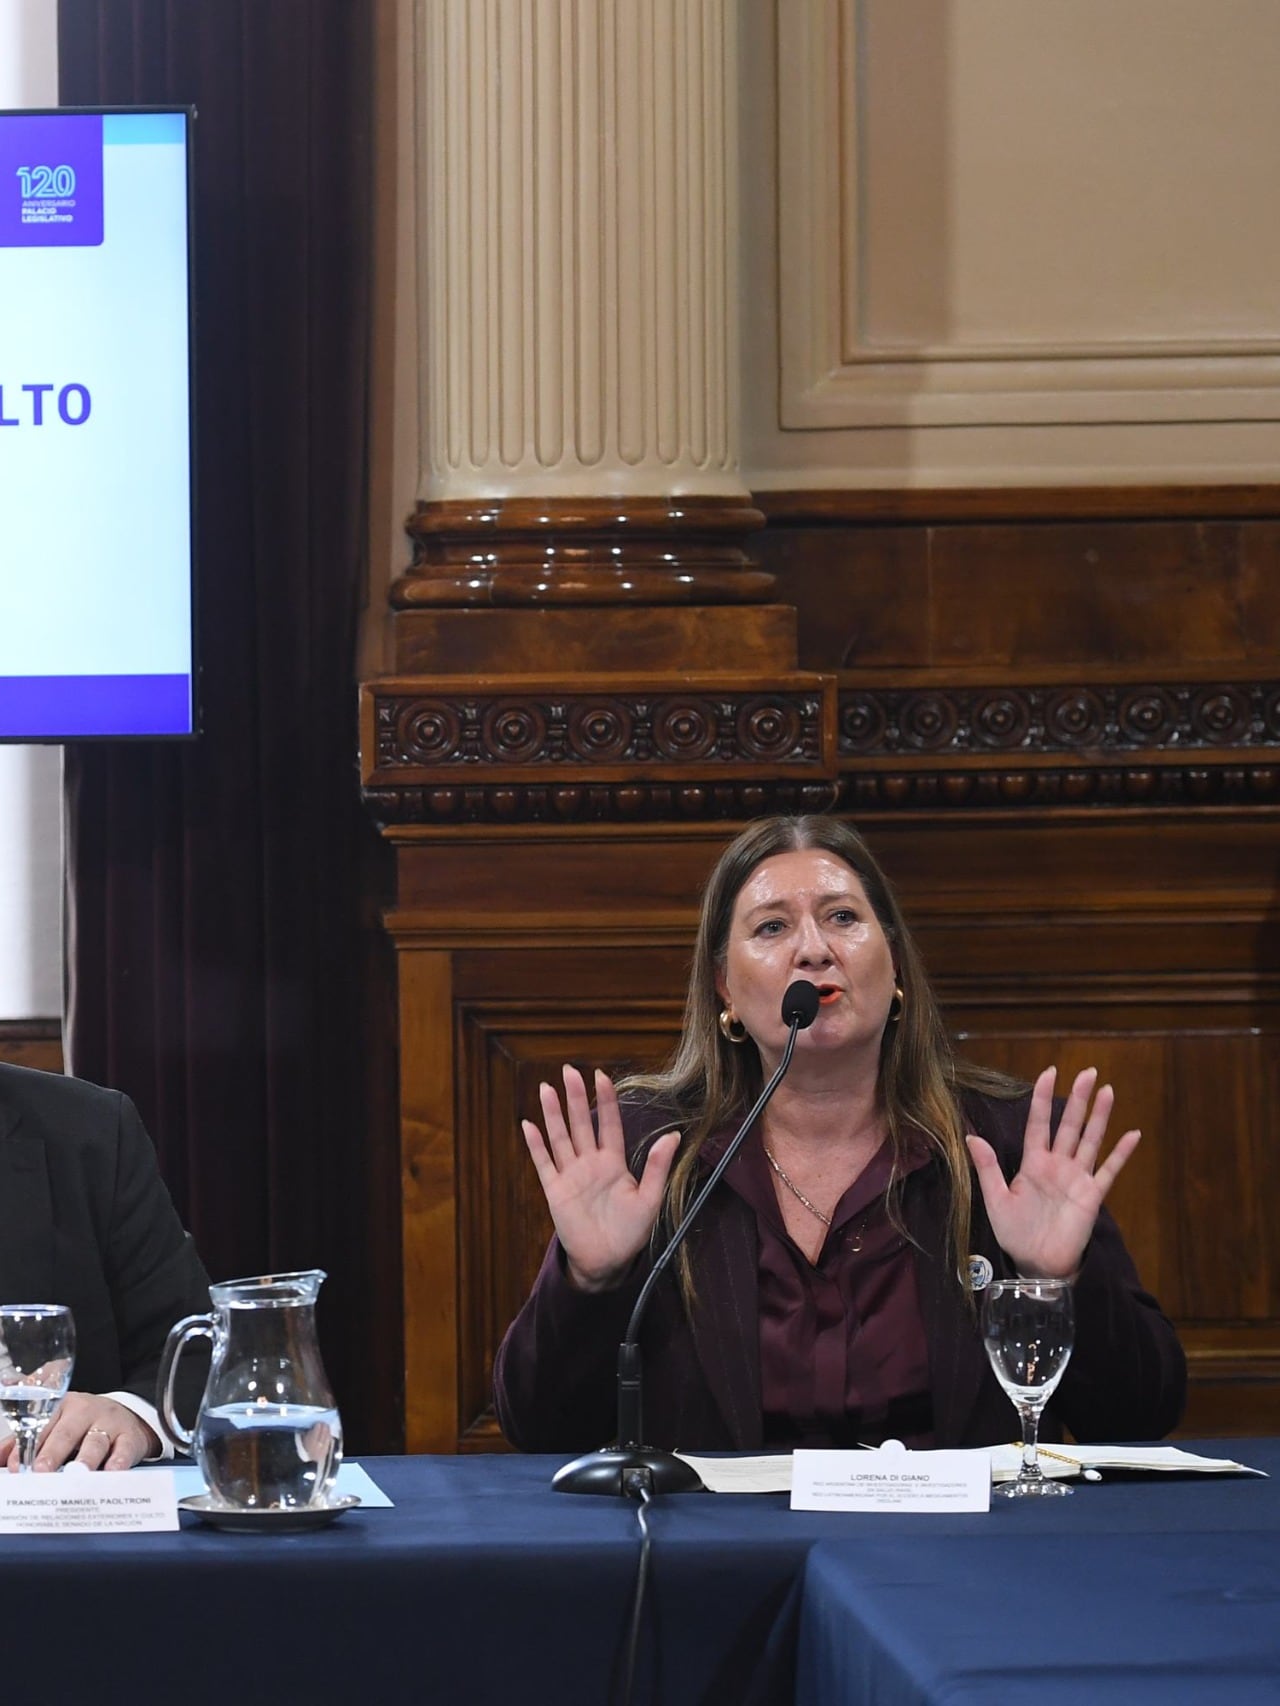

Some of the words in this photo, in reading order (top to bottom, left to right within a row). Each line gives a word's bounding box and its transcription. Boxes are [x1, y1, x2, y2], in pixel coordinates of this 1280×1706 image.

[16, 164, 76, 198] 120
[22, 207, 58, 215] PALACIO
[22, 214, 74, 223] LEGISLATIVO
[901, 1474, 930, 1482] GIANO
[6, 1498, 58, 1506] FRANCISCO
[99, 1497, 152, 1505] PAOLTRONI
